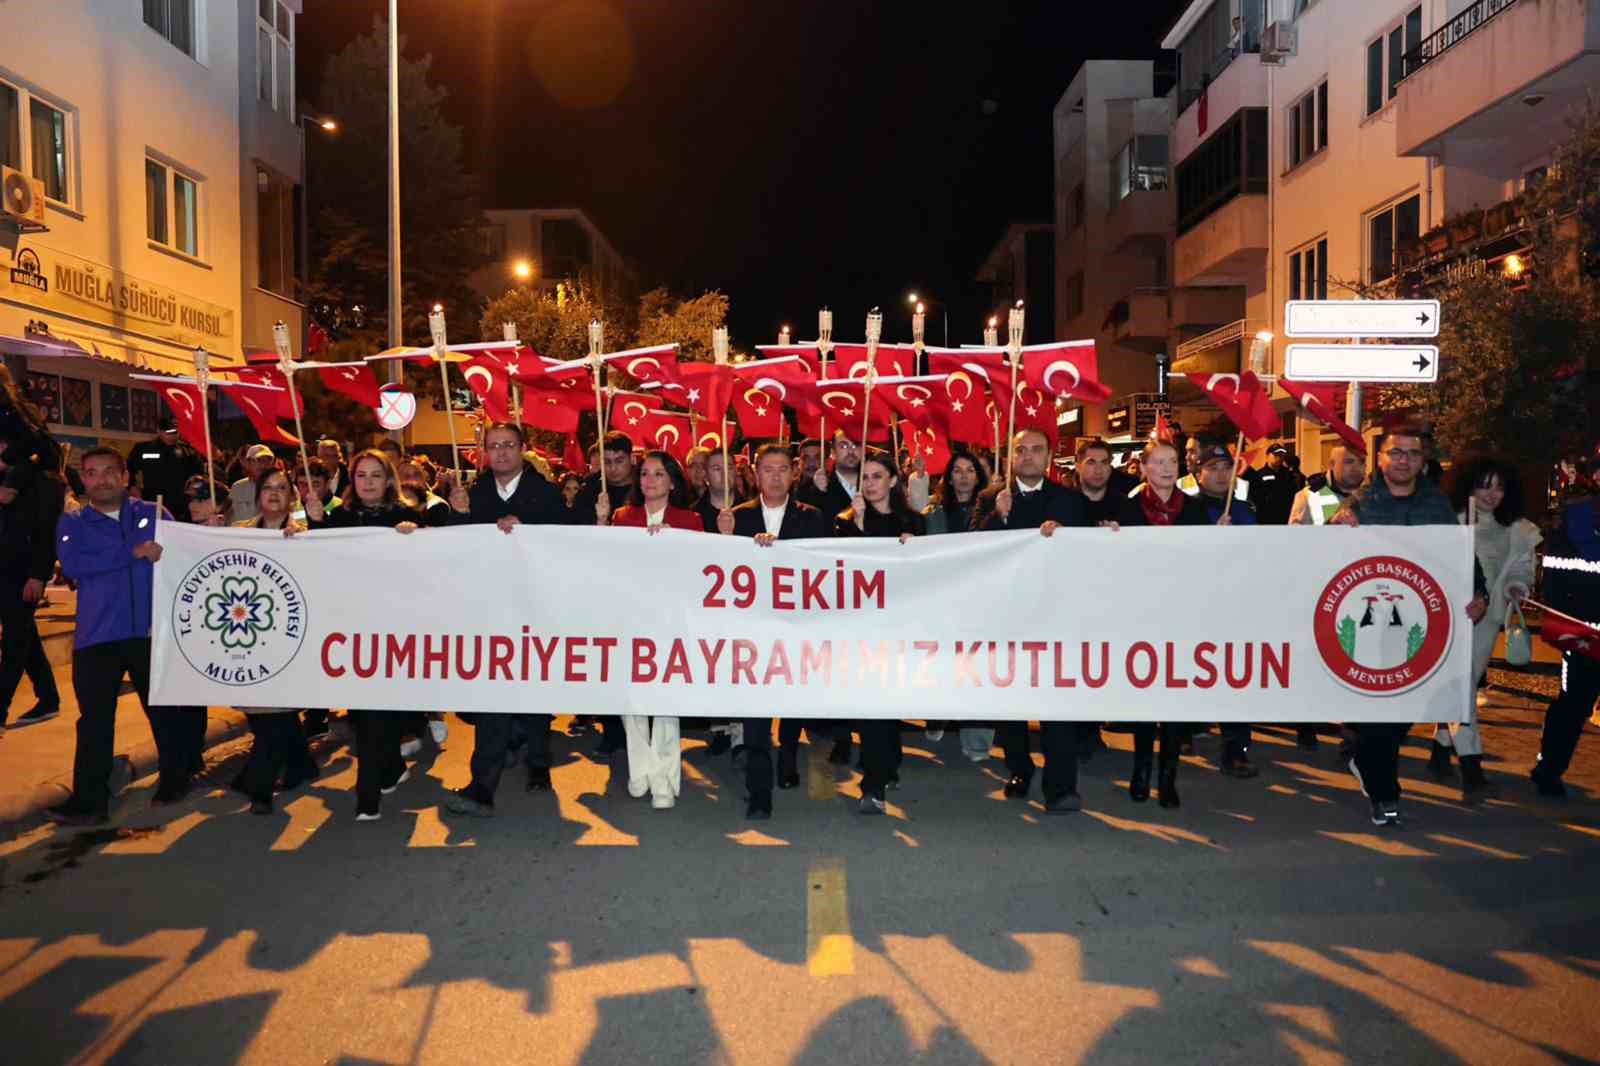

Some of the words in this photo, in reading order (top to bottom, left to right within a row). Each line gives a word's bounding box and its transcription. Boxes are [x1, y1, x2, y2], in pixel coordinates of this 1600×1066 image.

[55, 265, 114, 304] MUĞLA
[120, 282, 177, 323] SÜRÜCÜ
[180, 305, 221, 335] KURSU
[181, 552, 257, 604] BÜYÜKŞEHİR
[702, 564, 757, 609] 29
[772, 559, 886, 610] EKİM
[1323, 564, 1374, 613] BELEDİYE
[1376, 563, 1441, 613] BAŞKANLIĞI
[179, 609, 192, 637] T.C.
[204, 662, 271, 683] MUĞLA
[320, 625, 617, 683] CUMHURİYET
[631, 637, 940, 688] BAYRAMIMIZ
[954, 640, 1110, 688] KUTLU
[1125, 641, 1291, 689] OLSUN
[1347, 667, 1414, 685] MENTEŞE
